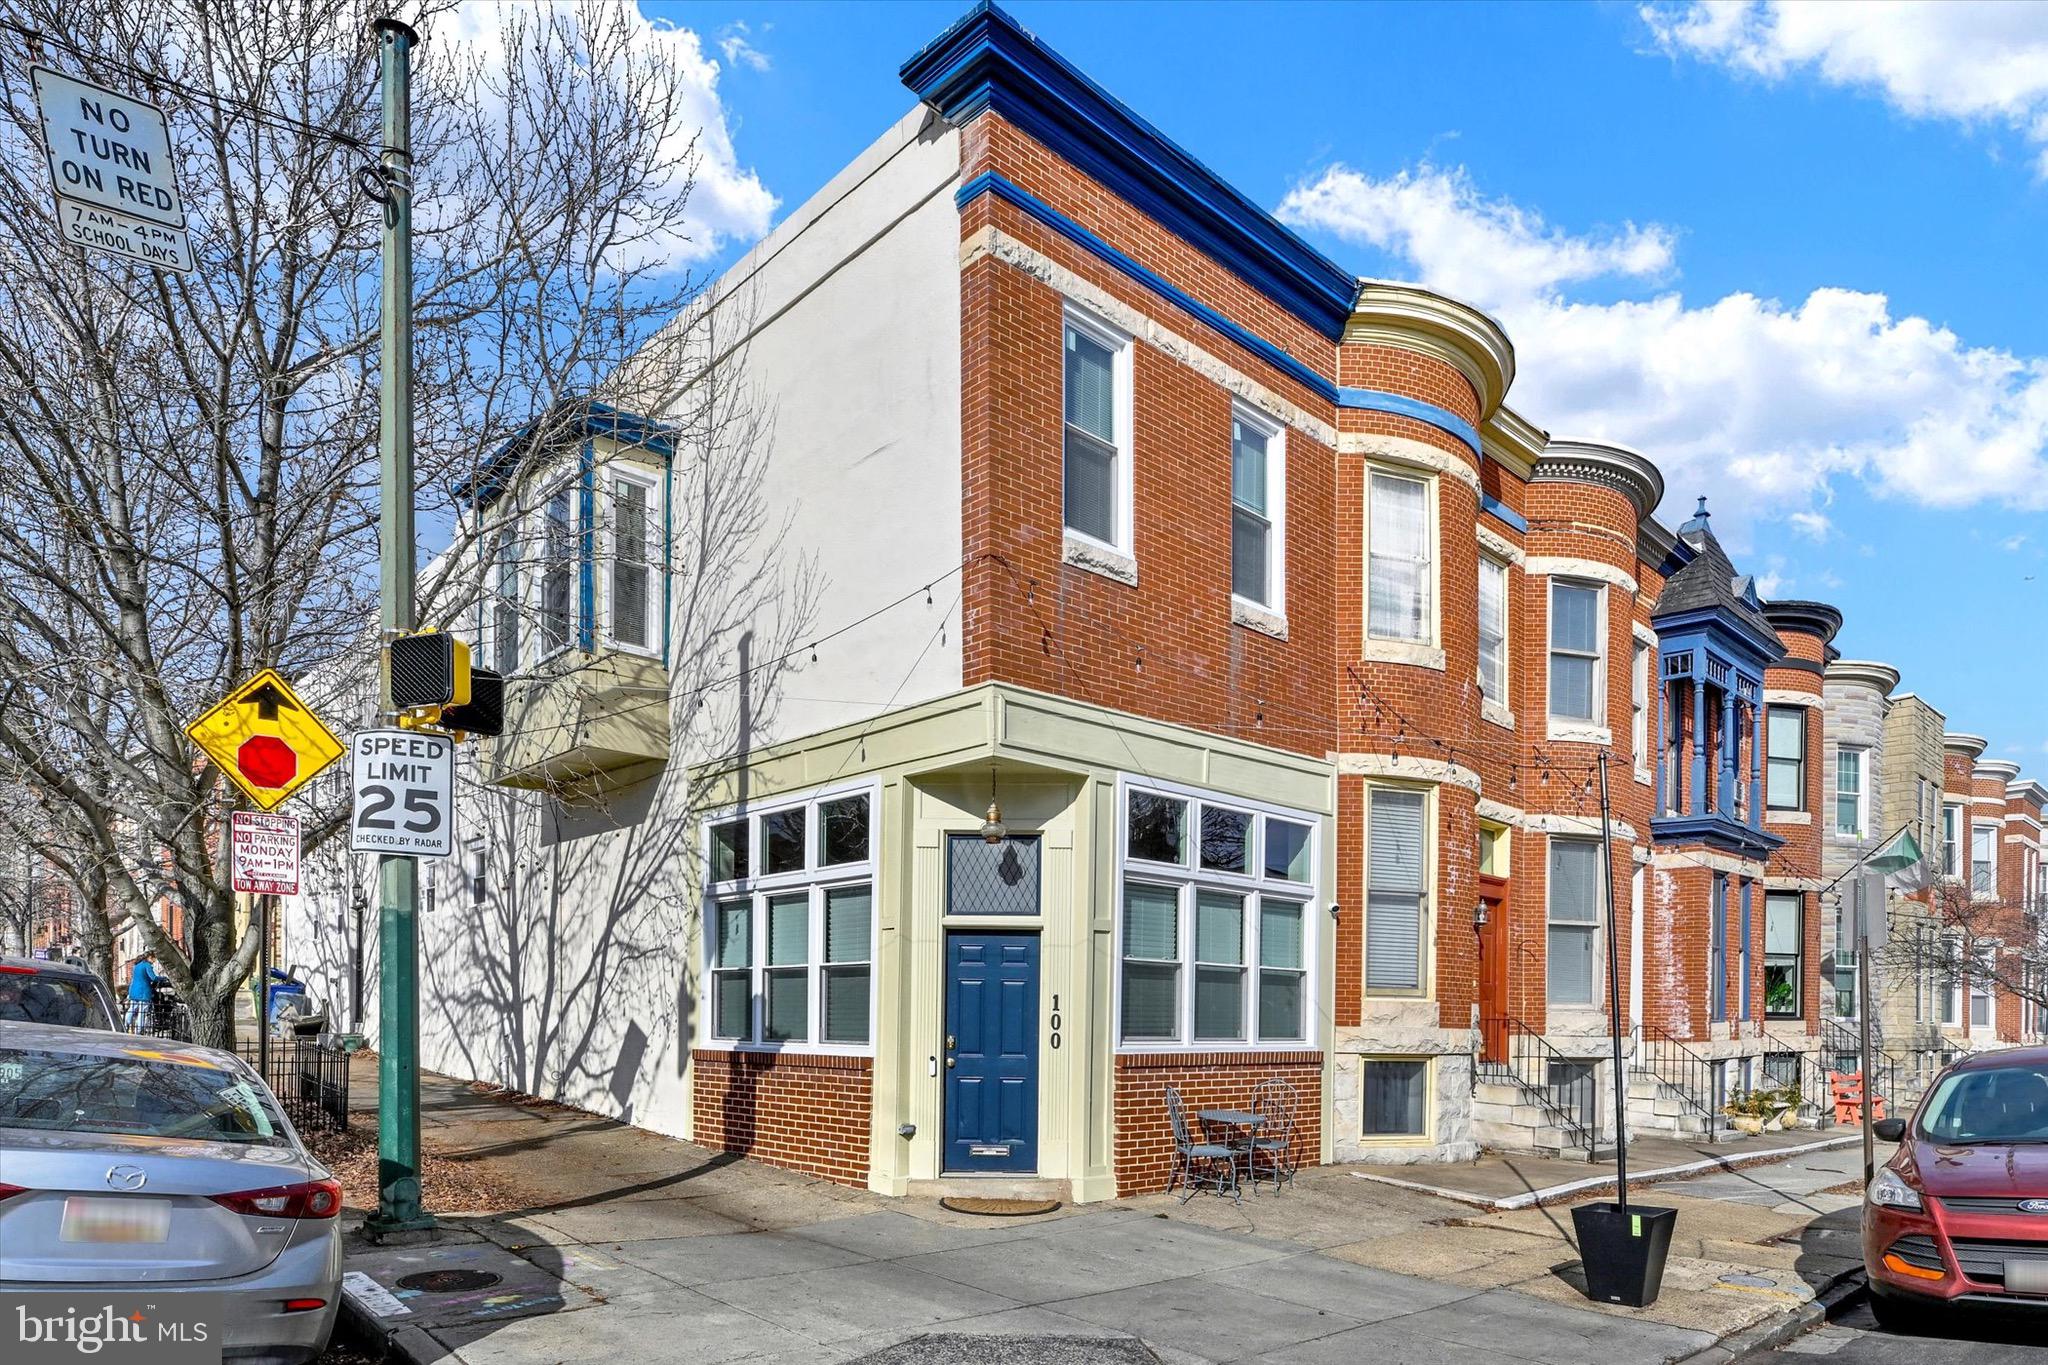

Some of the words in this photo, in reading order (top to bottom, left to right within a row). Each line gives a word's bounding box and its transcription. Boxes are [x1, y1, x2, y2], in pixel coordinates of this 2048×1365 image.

[80, 96, 130, 133] NO
[70, 127, 151, 175] TURN
[61, 160, 104, 193] ON
[116, 175, 174, 212] RED
[71, 223, 136, 253] SCHOOL
[142, 242, 179, 265] DAYS
[360, 737, 444, 759] SPEED
[367, 762, 432, 783] LIMIT
[357, 785, 442, 833] 25
[236, 814, 251, 824] NO
[254, 816, 296, 830] STOPPING
[236, 832, 251, 842] NO
[254, 834, 296, 847] PARKING
[356, 834, 395, 845] CHECKED
[399, 836, 411, 846] BY
[414, 838, 443, 849] RADAR
[240, 844, 294, 858] MONDAY
[236, 879, 252, 890] TOW
[253, 881, 274, 892] AWAY
[276, 882, 296, 894] ZONE
[1051, 994, 1061, 1049] 100
